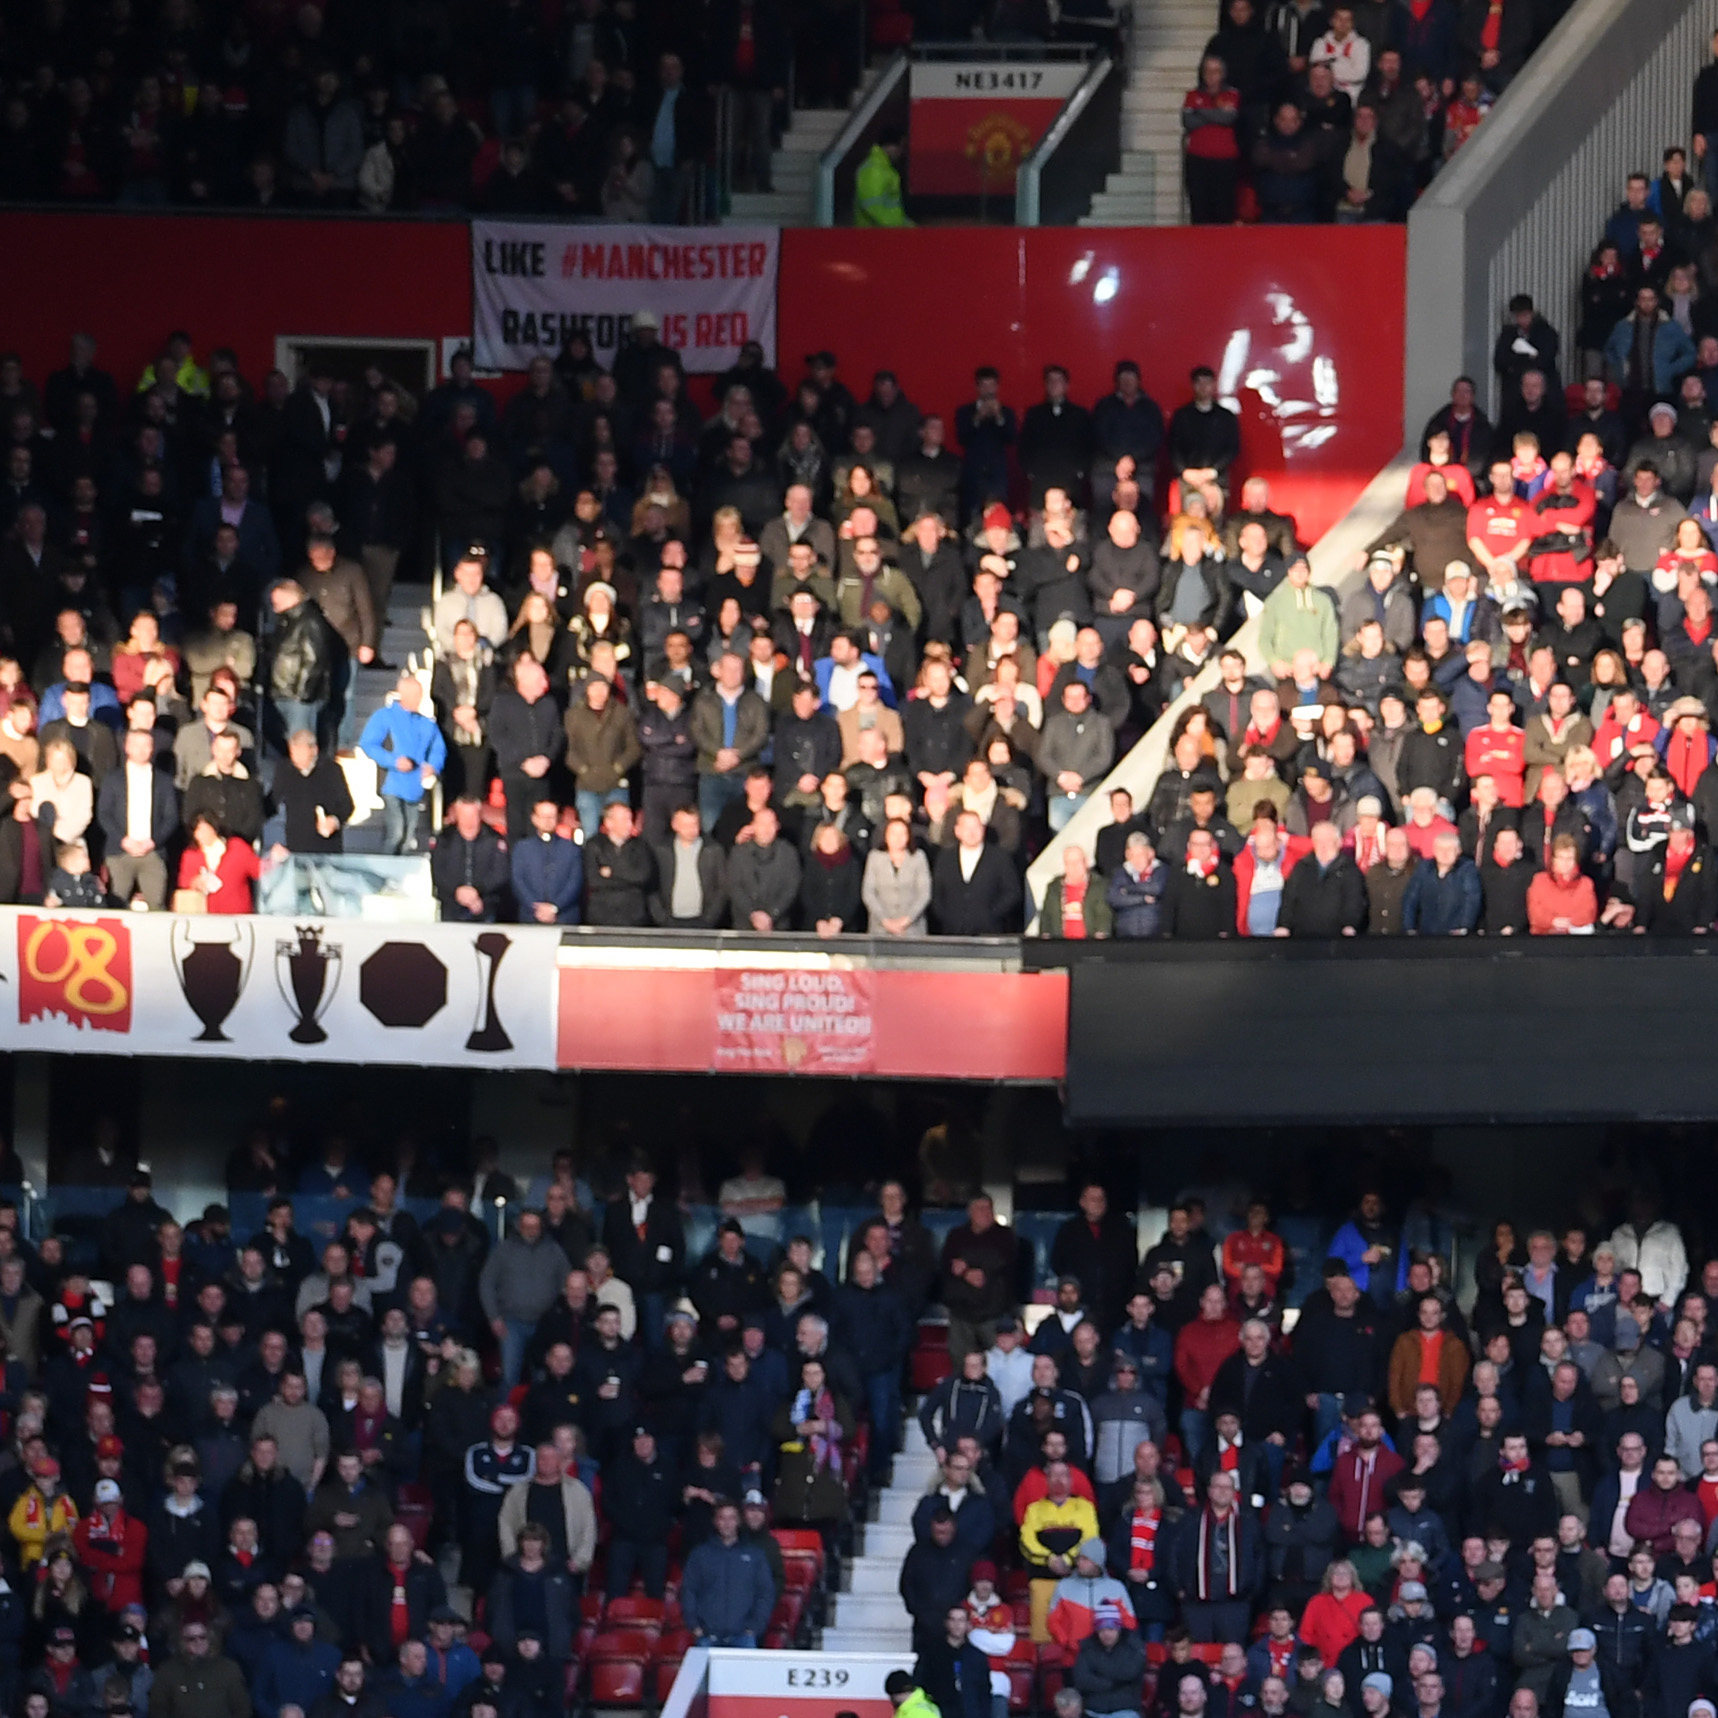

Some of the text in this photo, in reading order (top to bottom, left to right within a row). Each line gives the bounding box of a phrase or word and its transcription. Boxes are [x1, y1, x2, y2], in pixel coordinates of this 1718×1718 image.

[956, 73, 1042, 90] NE3417
[485, 240, 767, 280] LIKE #MANCHESTER
[662, 314, 687, 349] IS
[695, 312, 748, 347] RED
[741, 973, 785, 990] SING
[735, 993, 779, 1009] SING
[717, 1013, 746, 1030] WE
[750, 1014, 785, 1031] ARE
[787, 1669, 850, 1687] E239
